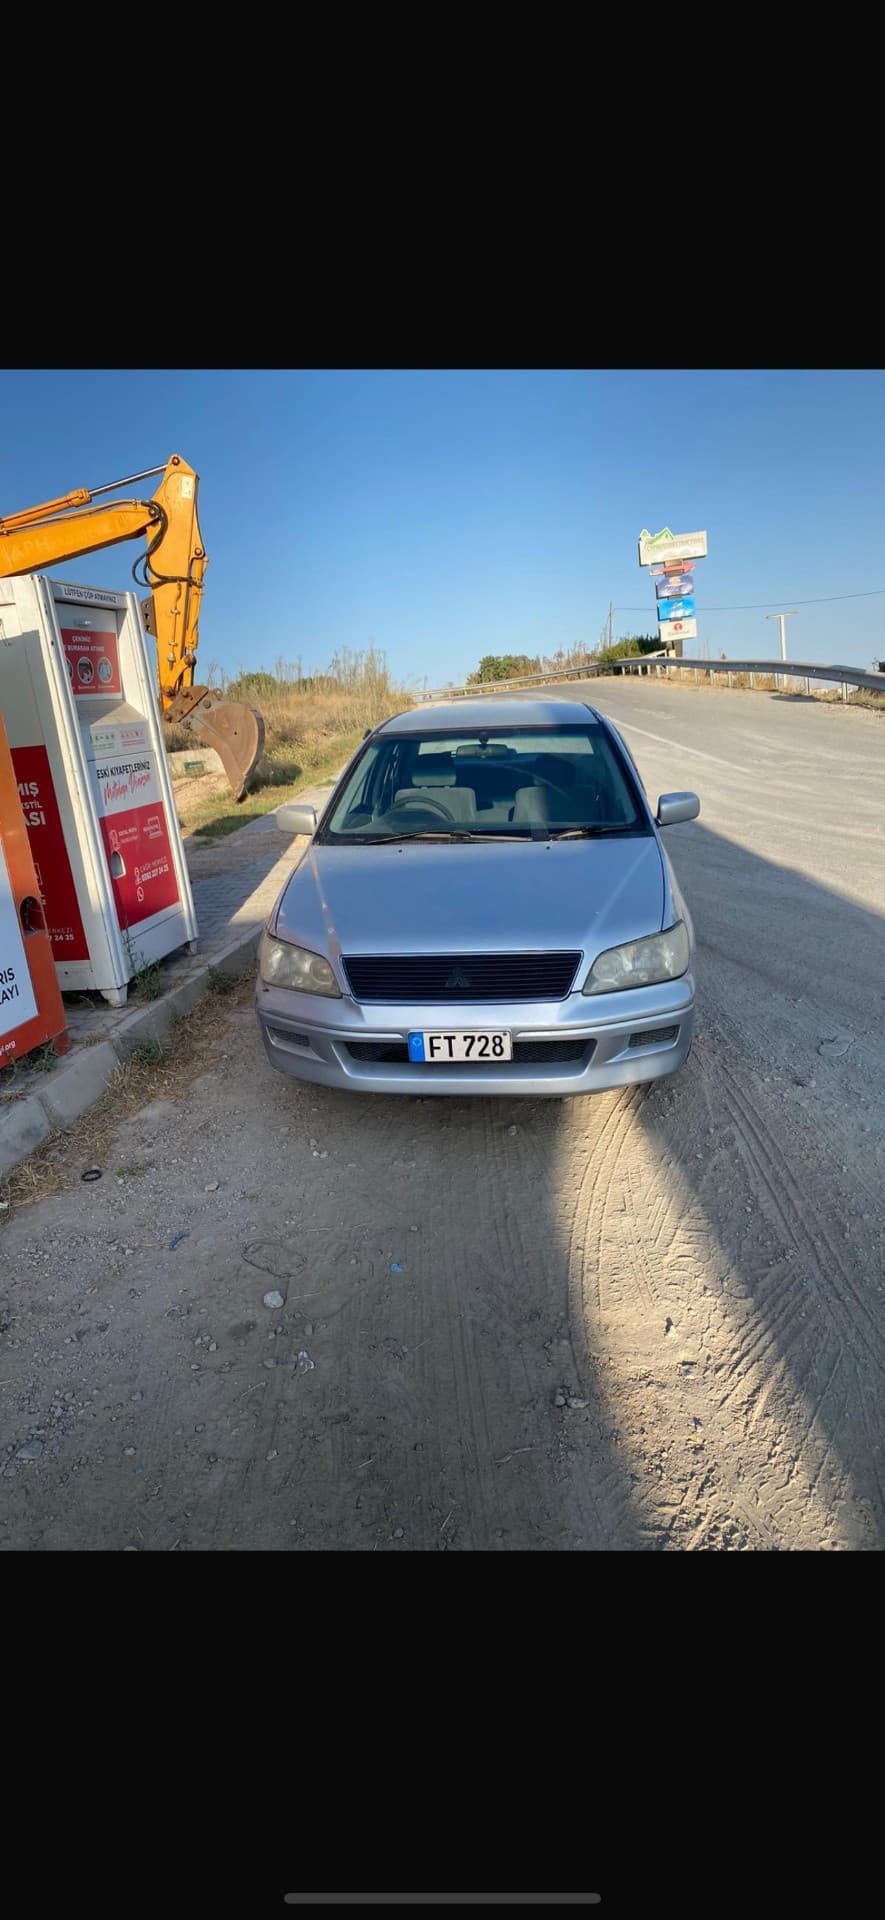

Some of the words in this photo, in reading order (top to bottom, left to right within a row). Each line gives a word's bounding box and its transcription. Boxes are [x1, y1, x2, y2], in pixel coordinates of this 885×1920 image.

[0, 983, 19, 1005] AYI
[429, 1035, 456, 1058] FT
[463, 1034, 504, 1057] 728
